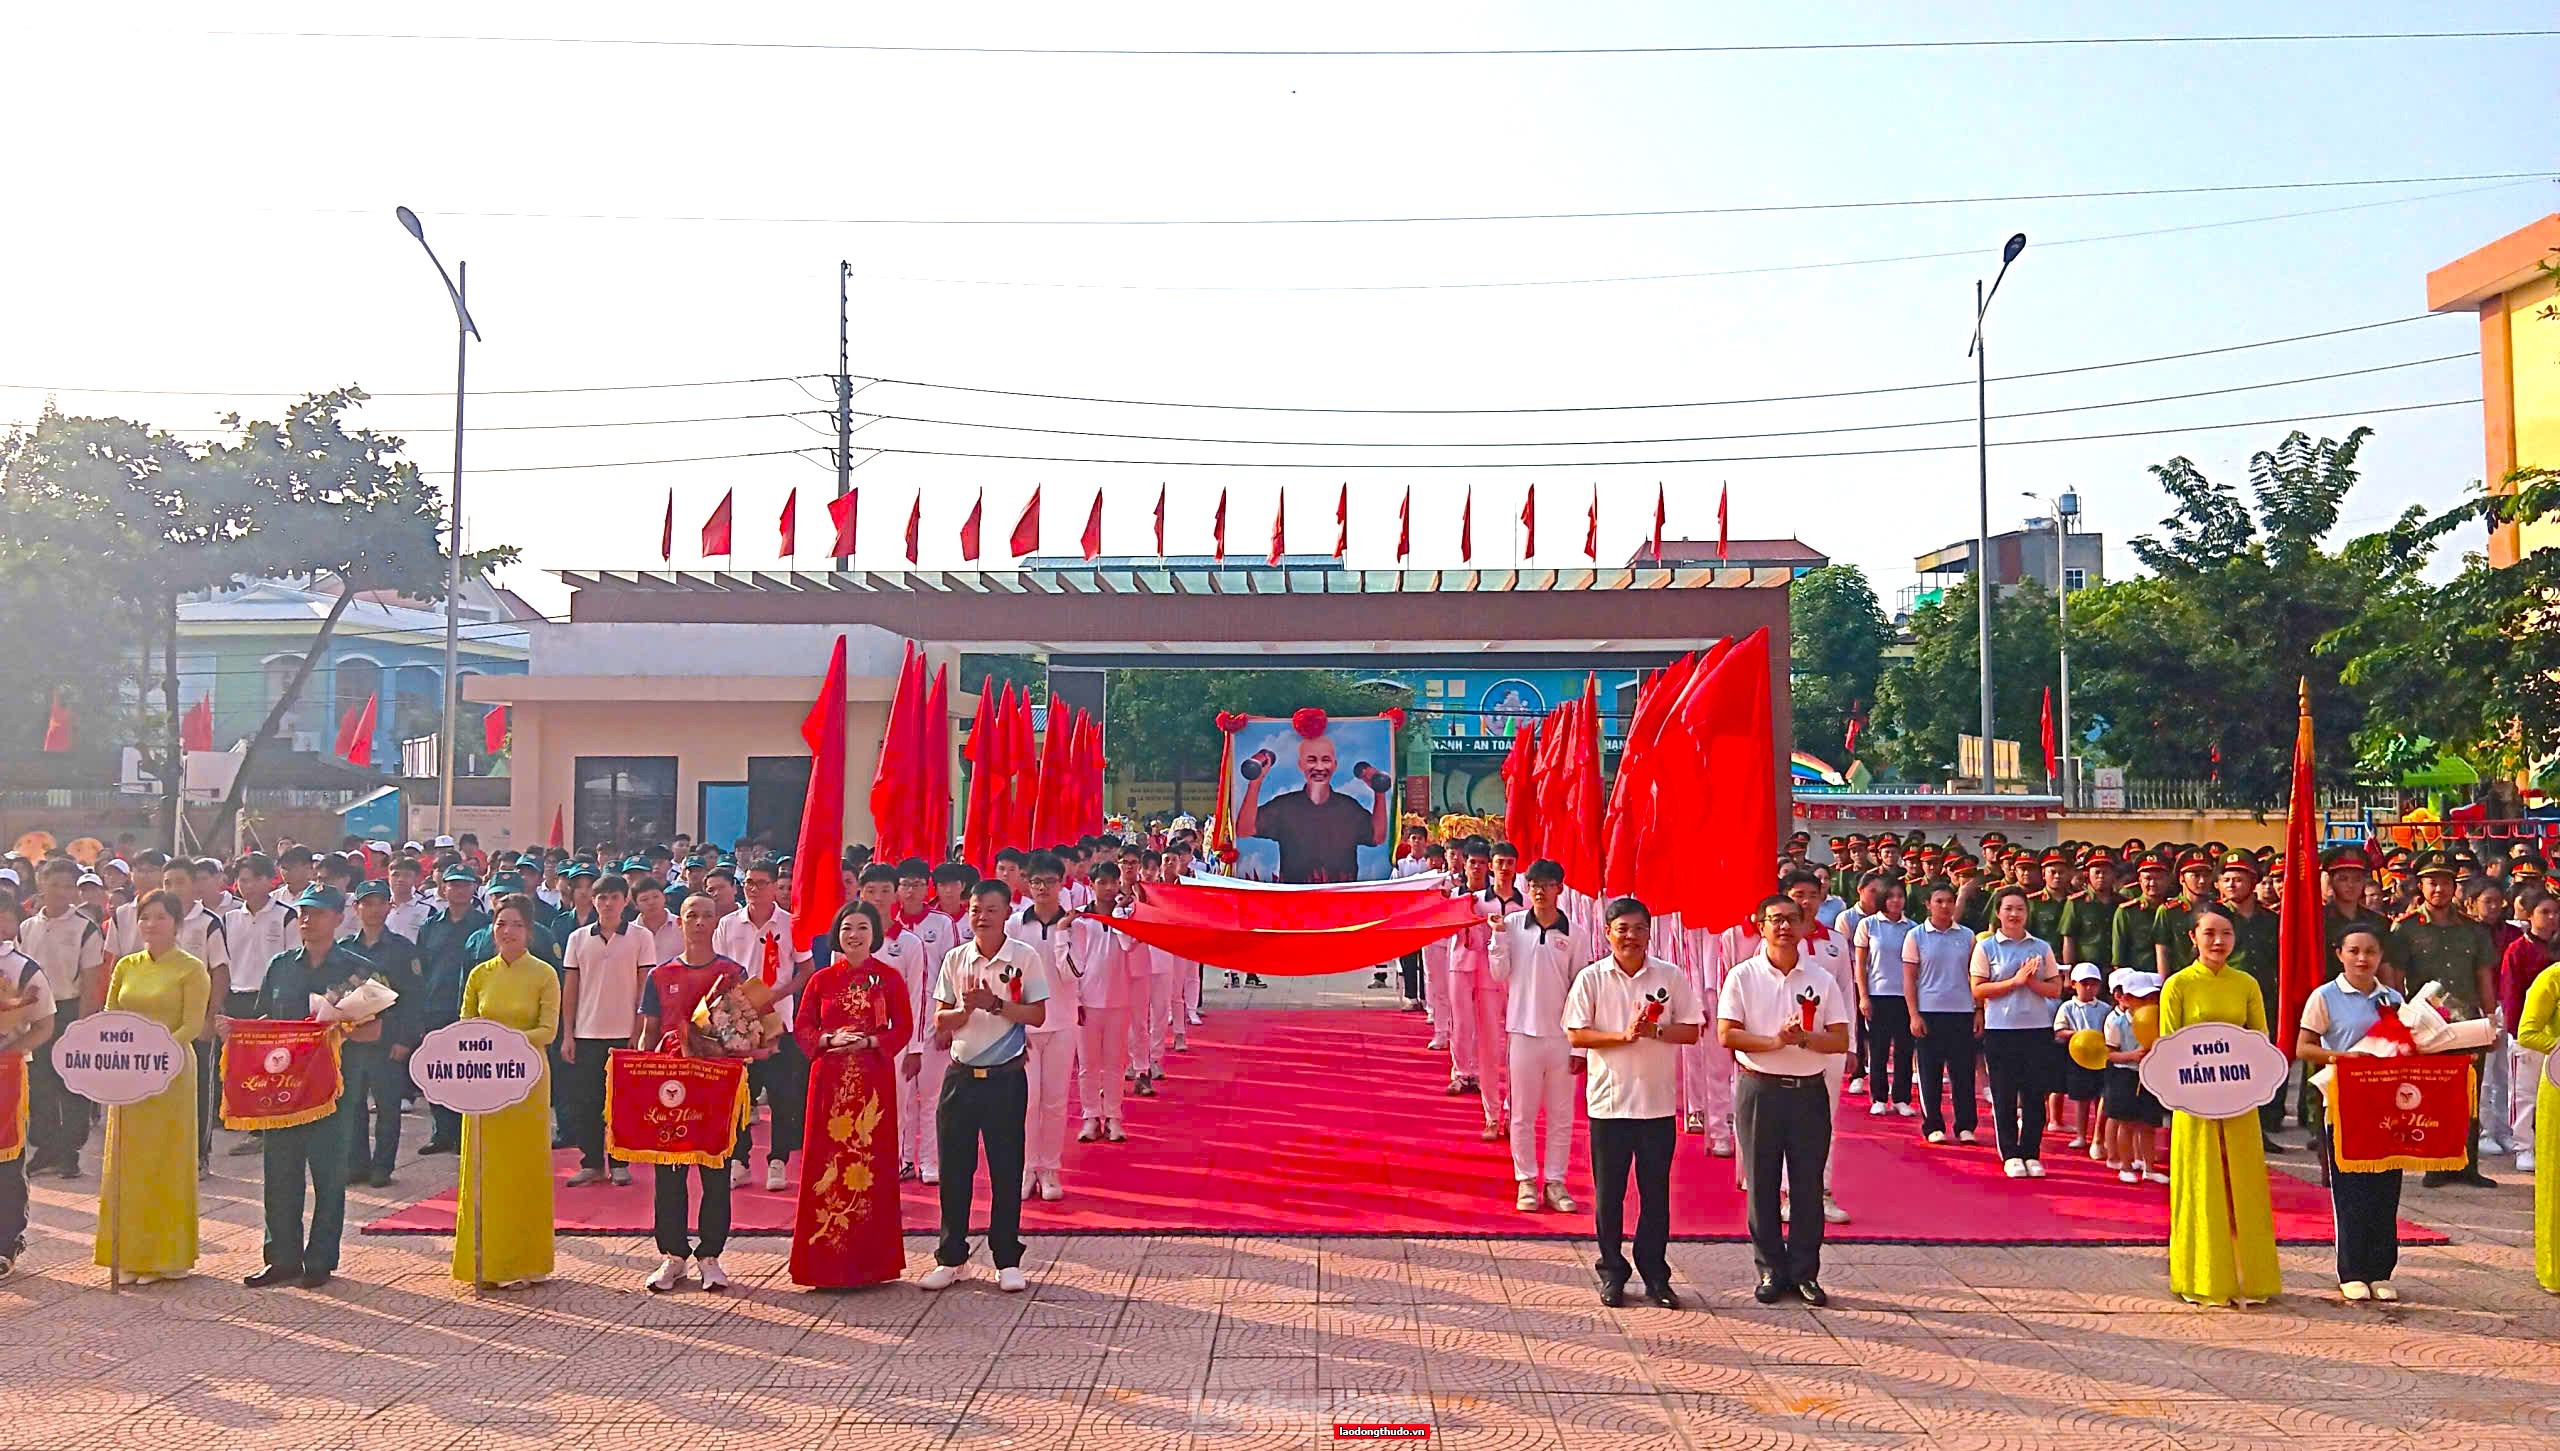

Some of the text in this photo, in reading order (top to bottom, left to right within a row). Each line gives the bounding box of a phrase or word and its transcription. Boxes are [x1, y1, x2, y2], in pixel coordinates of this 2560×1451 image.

[1474, 740, 1489, 750] AN
[100, 1027, 134, 1042] KHỐI
[459, 1036, 493, 1051] KHỐI
[2192, 1037, 2230, 1056] KHỐI
[65, 1050, 169, 1074] DÂN QUÂN TỰ VỆ
[427, 1059, 525, 1083] VẬN ĐỘNG VIÊN
[2179, 1061, 2251, 1085] MẦM NON
